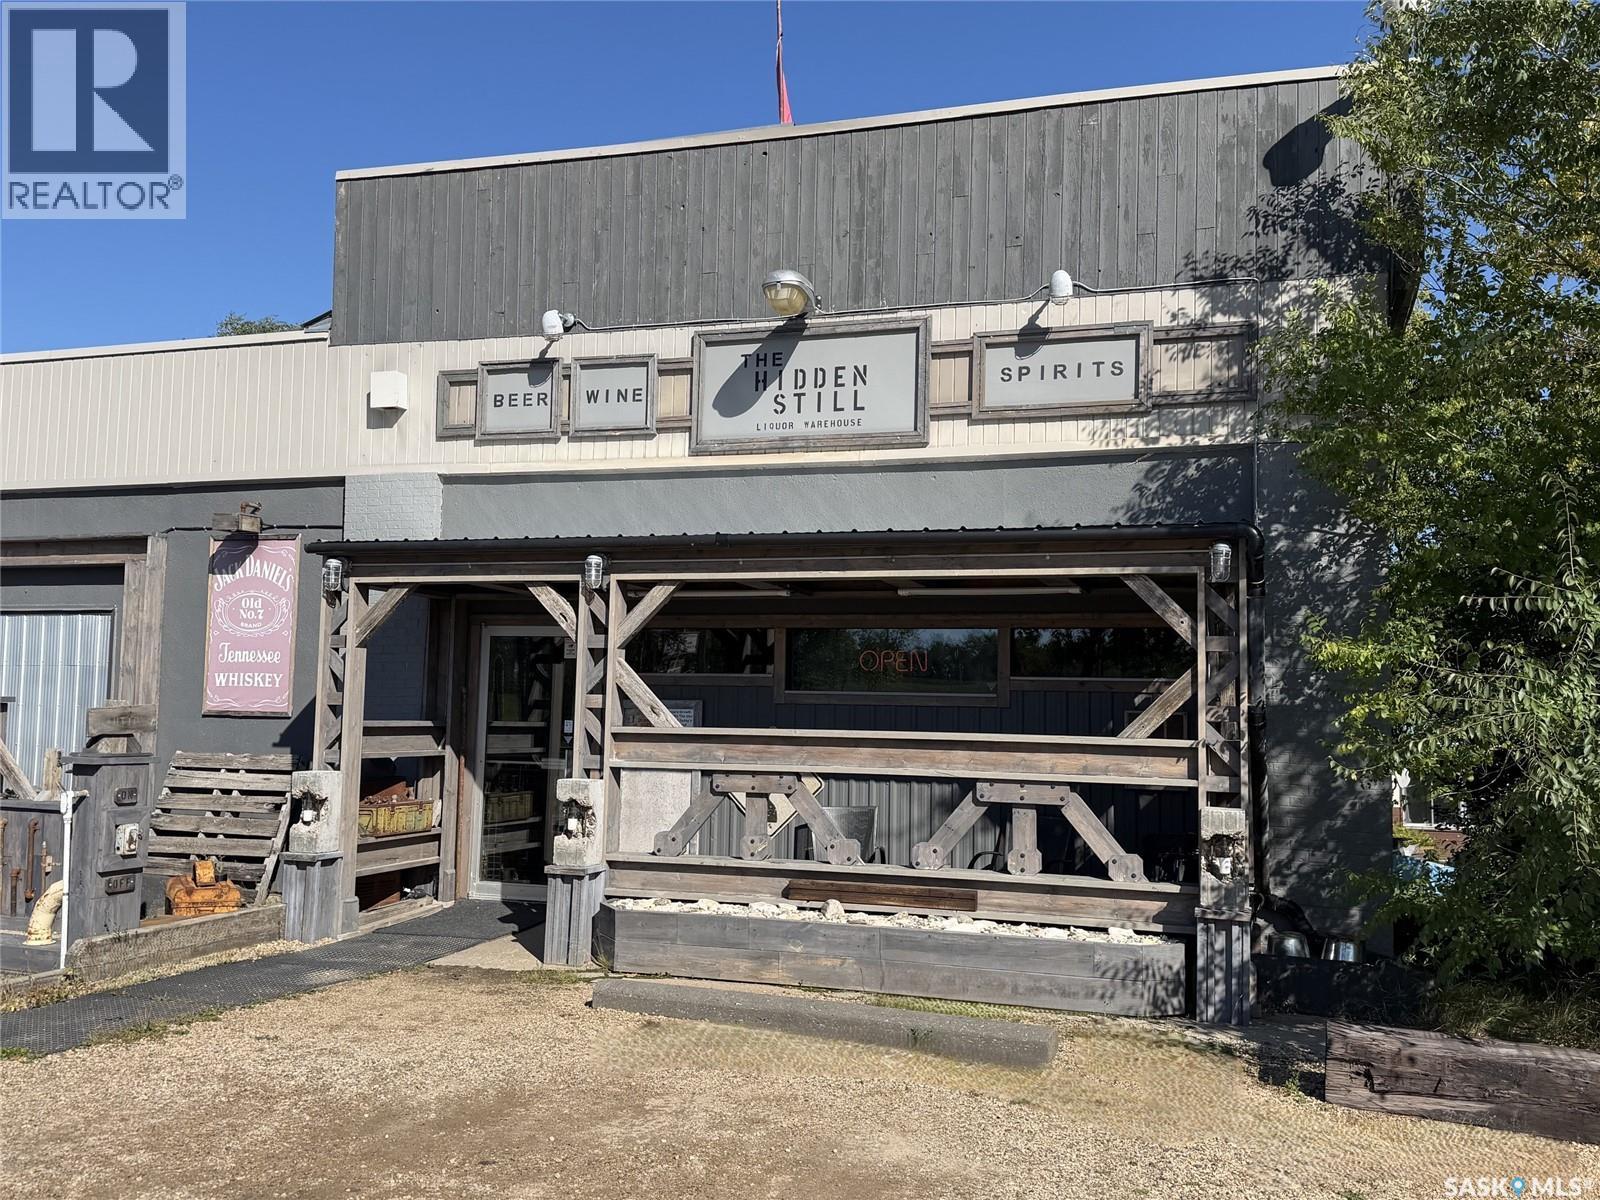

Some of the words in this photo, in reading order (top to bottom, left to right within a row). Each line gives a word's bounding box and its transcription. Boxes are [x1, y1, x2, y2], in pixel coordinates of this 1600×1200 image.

[741, 352, 783, 368] THE
[755, 364, 868, 392] HIDDEN
[1000, 360, 1124, 382] SPIRITS
[493, 392, 548, 408] BEER
[586, 388, 643, 404] WINE
[773, 389, 866, 415] STILL
[756, 421, 794, 431] LIQUOR
[804, 418, 862, 429] WAREHOUSE
[214, 561, 245, 592] JACK
[245, 554, 294, 592] DANIEL'S
[241, 597, 262, 609] Old
[218, 642, 281, 664] Tennessee
[859, 650, 928, 672] OPEN
[214, 672, 283, 687] WHISKEY
